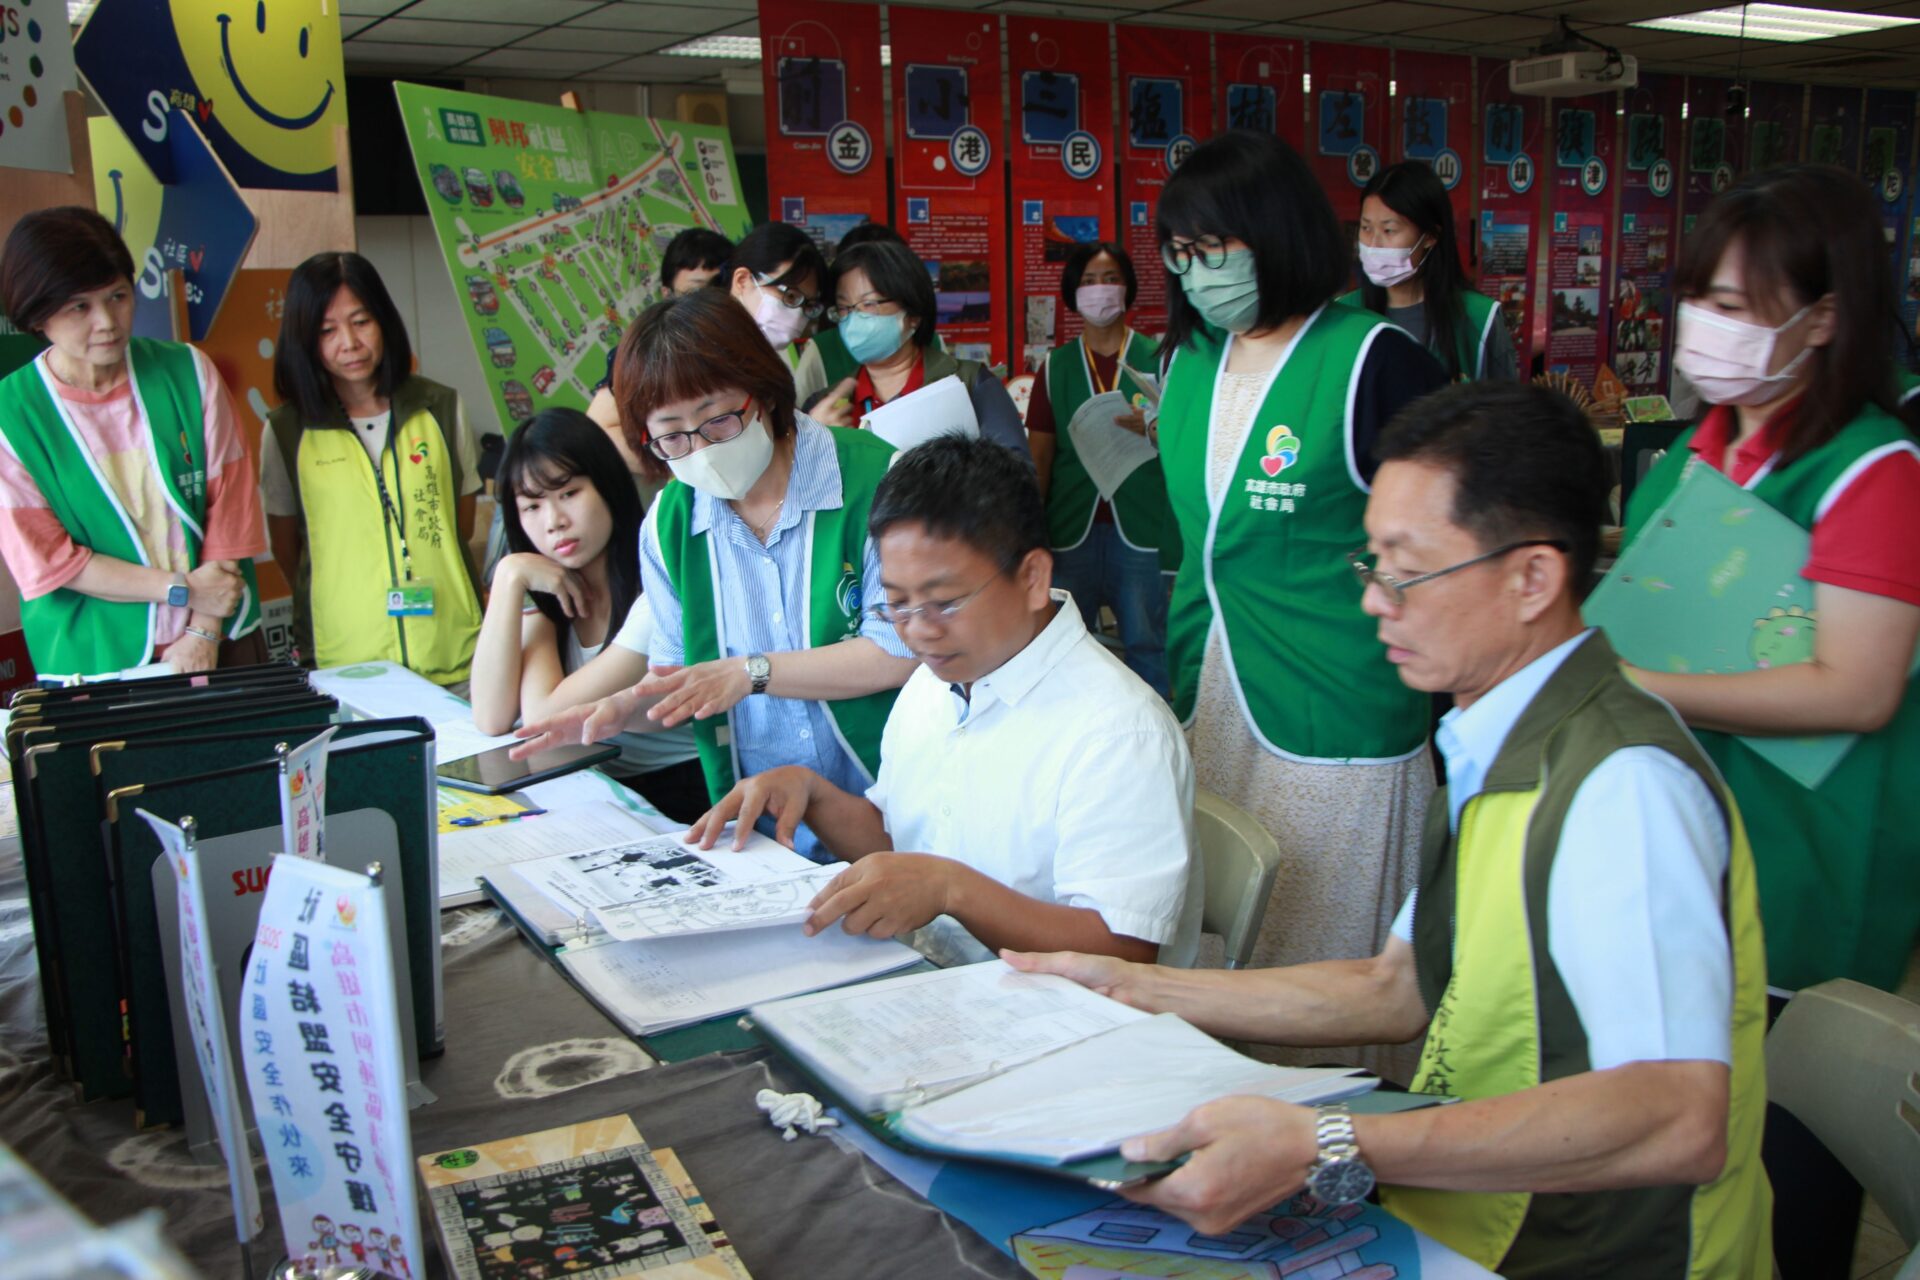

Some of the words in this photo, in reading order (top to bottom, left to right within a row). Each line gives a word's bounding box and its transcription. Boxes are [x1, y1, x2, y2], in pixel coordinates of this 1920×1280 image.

[838, 131, 860, 160] 金
[960, 135, 980, 164] 港
[1071, 141, 1091, 167] 民
[1439, 156, 1455, 178] 山
[1513, 160, 1529, 183] 鎮
[1587, 163, 1601, 185] 津
[1655, 166, 1669, 187] 竹
[413, 488, 429, 541] 社會局
[424, 465, 444, 549] 高雄市政府
